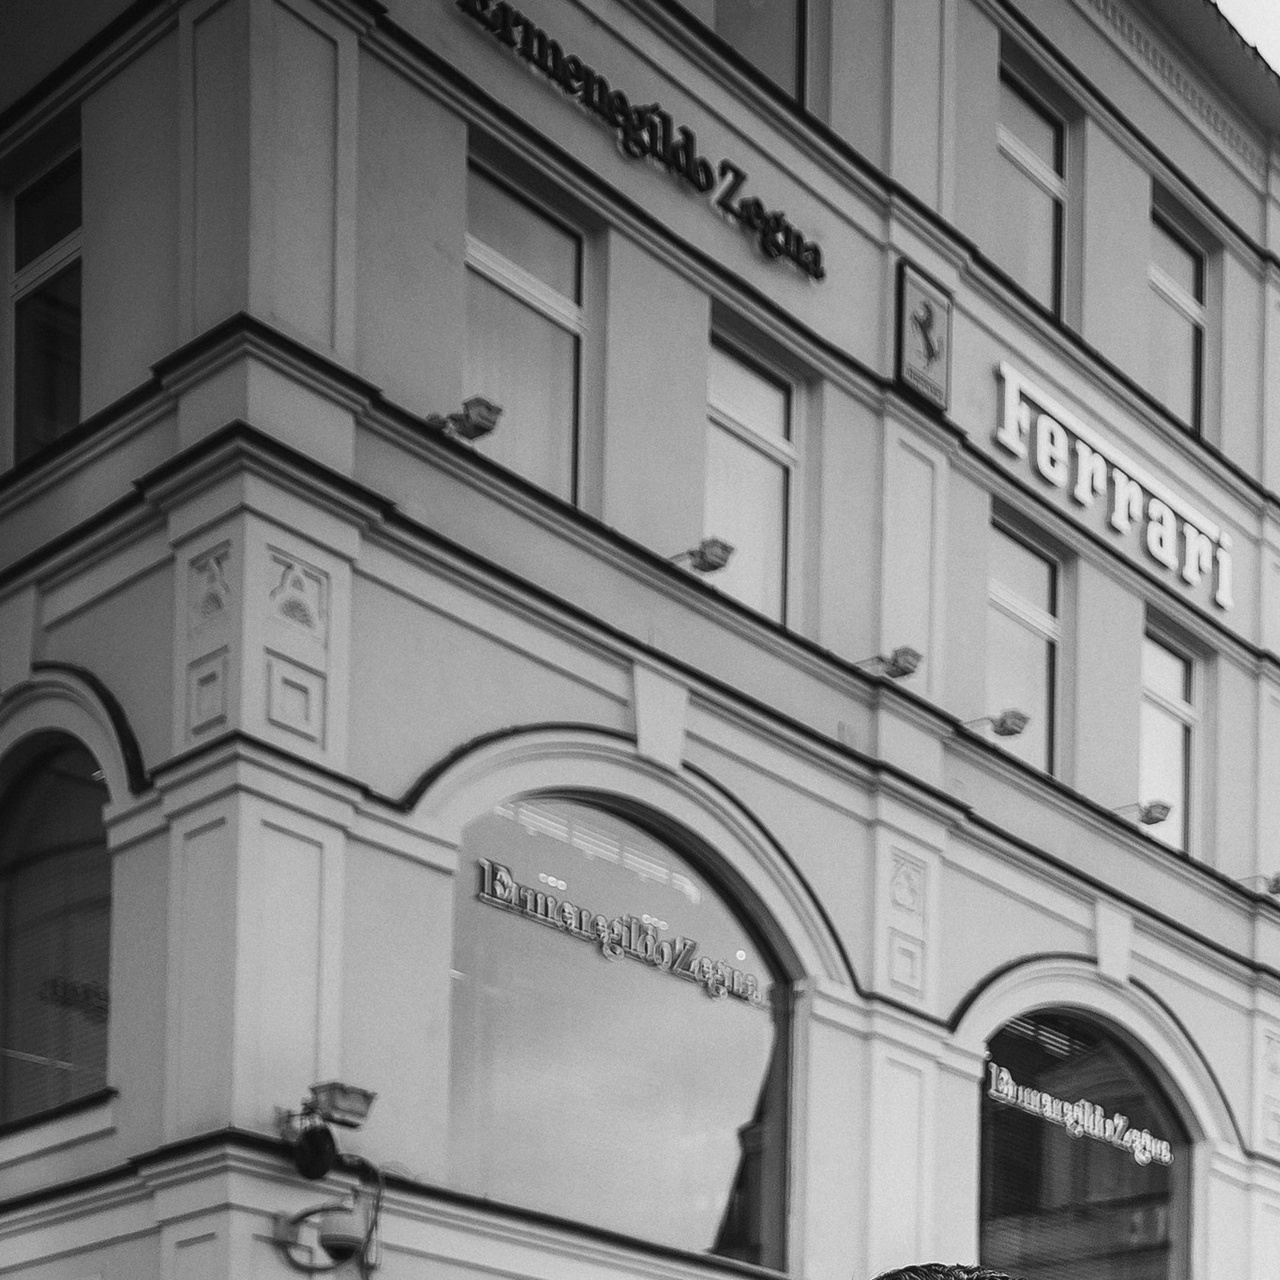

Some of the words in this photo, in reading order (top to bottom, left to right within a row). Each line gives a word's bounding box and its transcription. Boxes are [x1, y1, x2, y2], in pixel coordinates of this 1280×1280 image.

[711, 158, 825, 283] Zegna
[996, 359, 1234, 611] Ferrari
[671, 935, 768, 1001] Zegna
